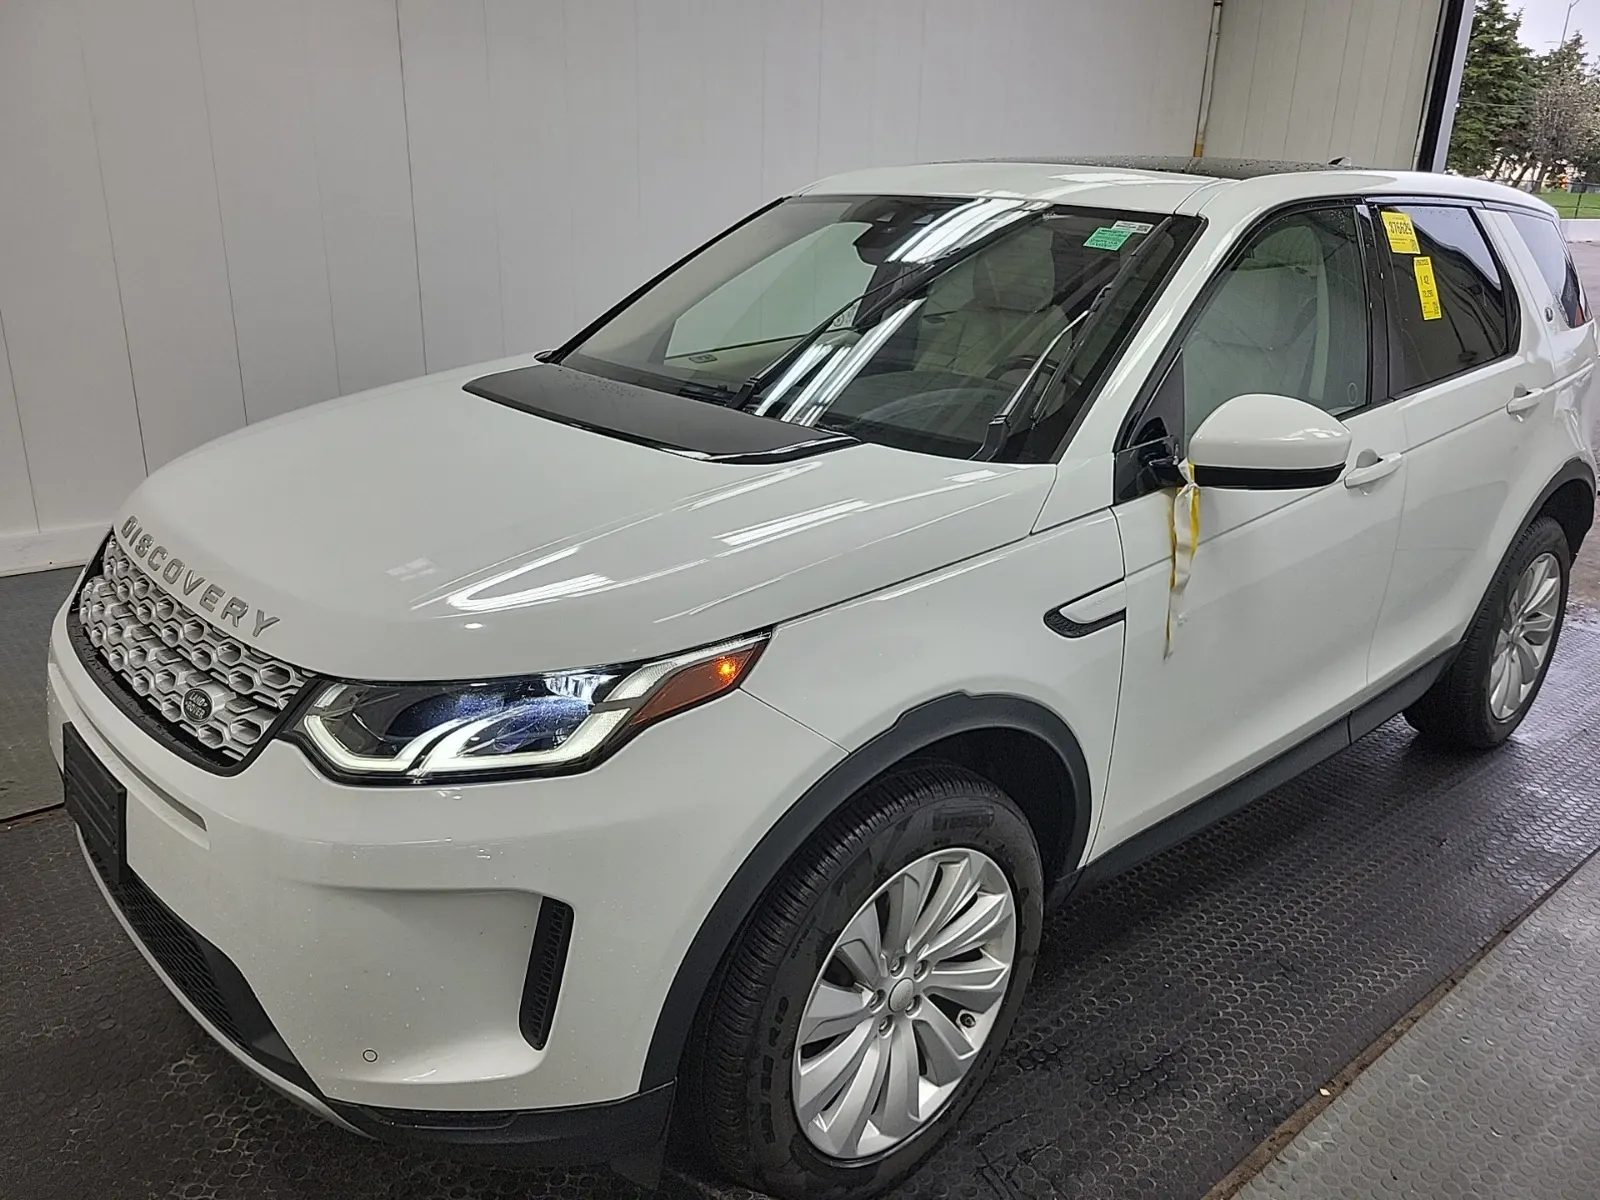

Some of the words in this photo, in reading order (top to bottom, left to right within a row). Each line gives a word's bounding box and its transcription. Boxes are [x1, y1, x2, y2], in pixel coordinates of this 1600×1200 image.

[121, 515, 280, 638] DISCOVERY
[189, 692, 205, 707] LAND
[186, 701, 206, 719] ROVER
